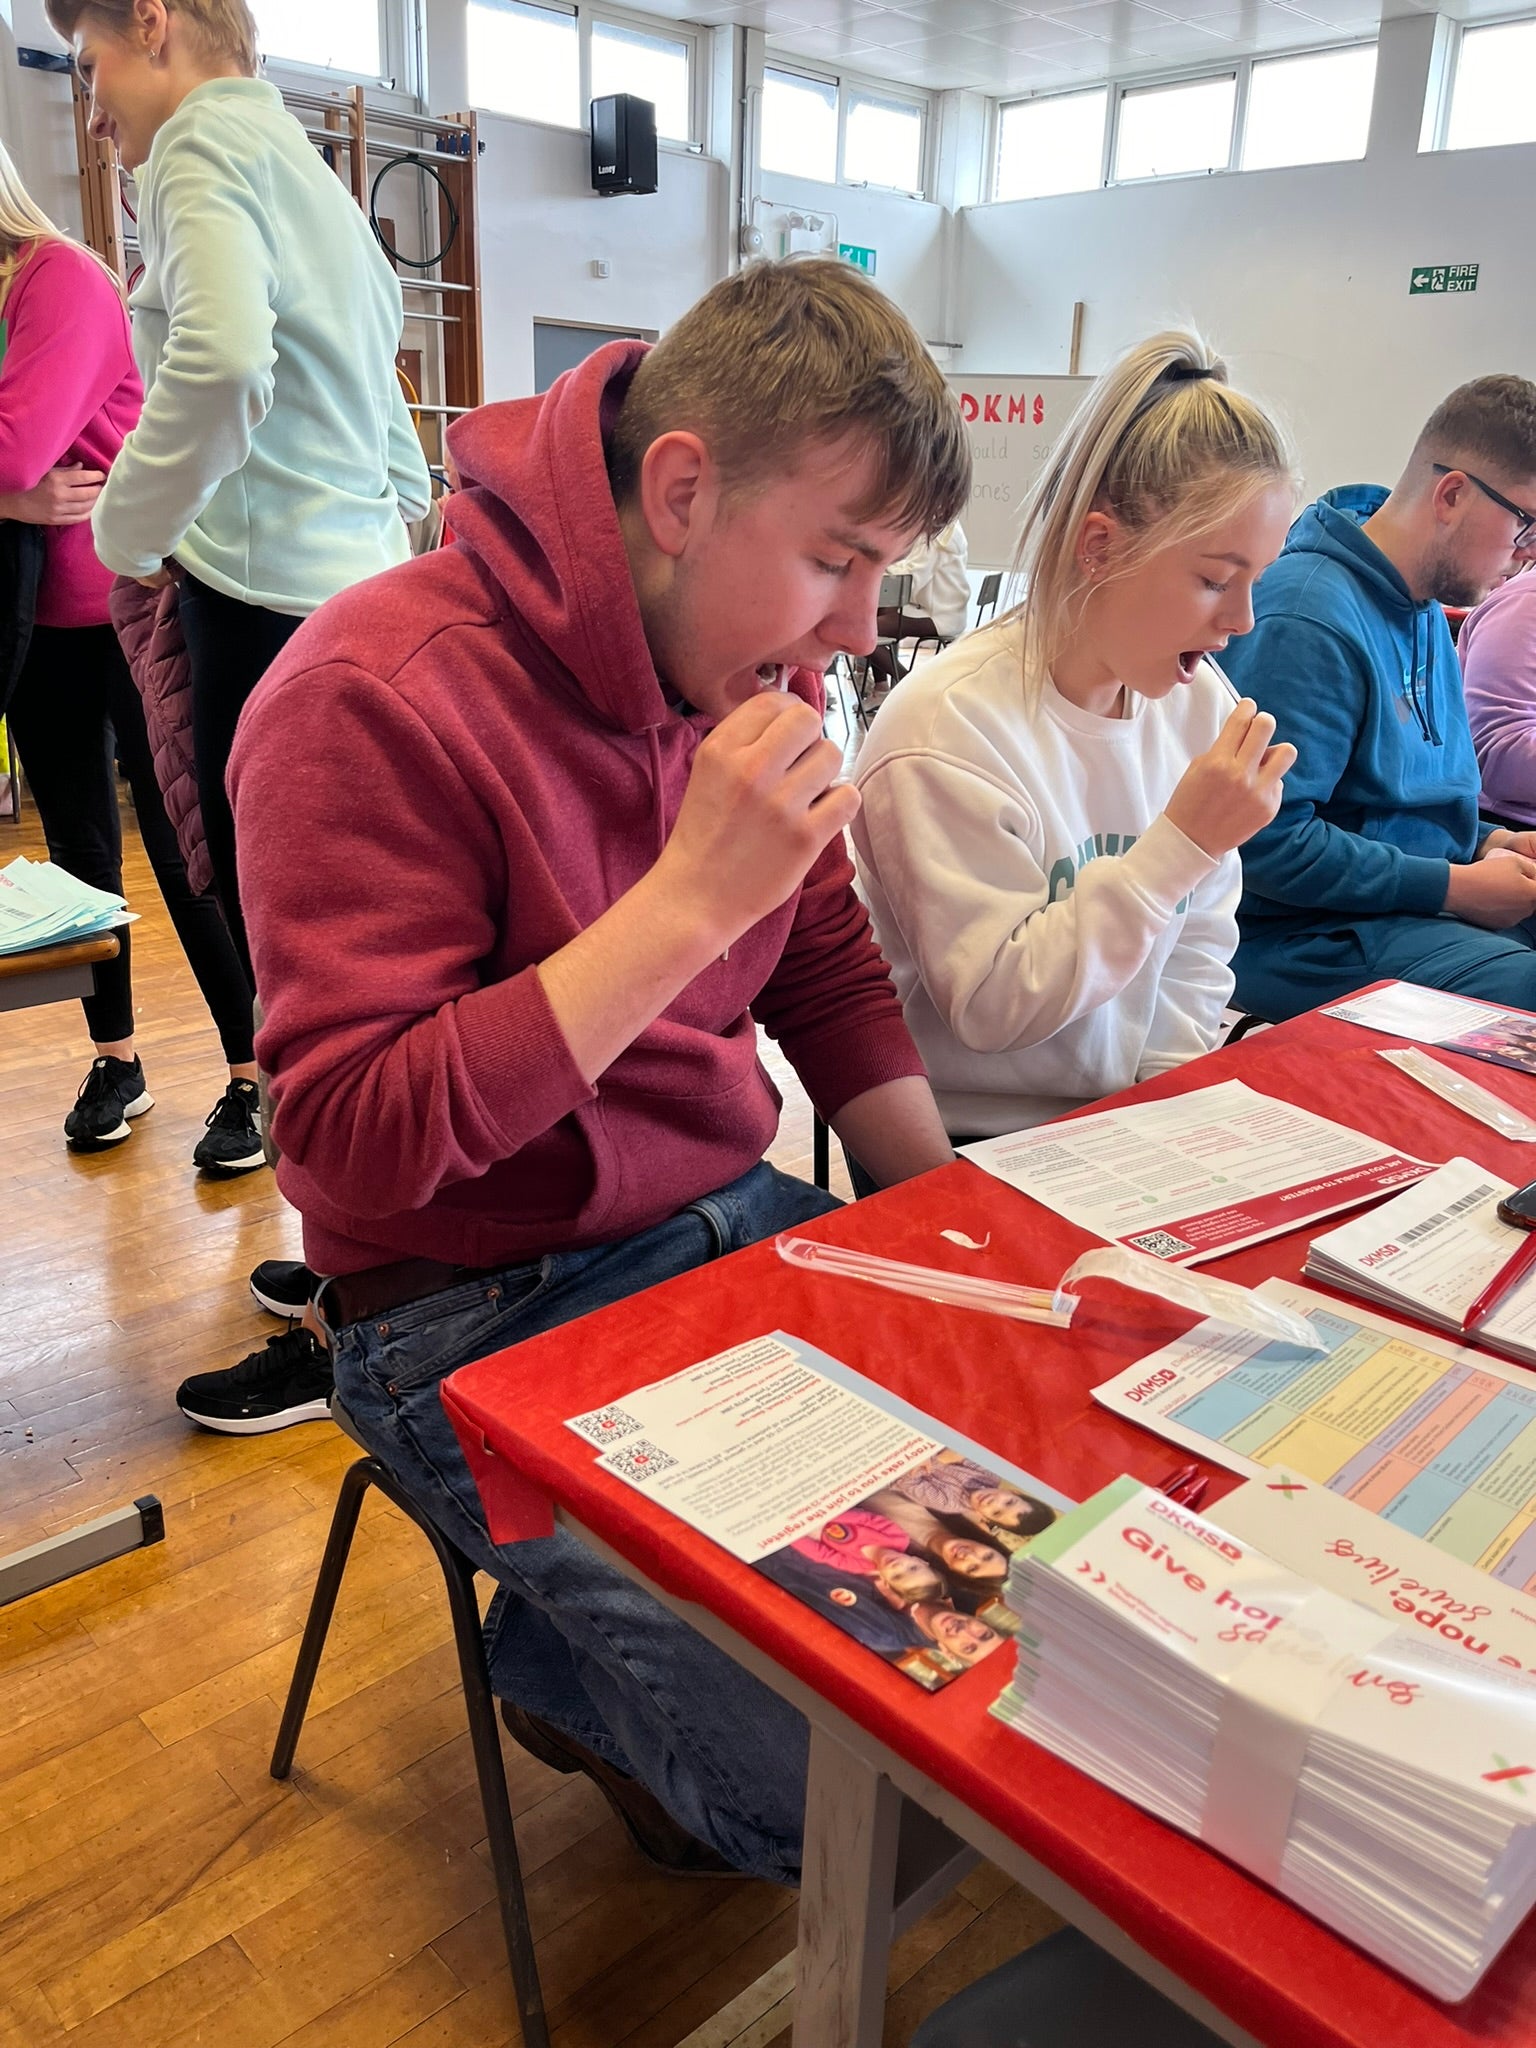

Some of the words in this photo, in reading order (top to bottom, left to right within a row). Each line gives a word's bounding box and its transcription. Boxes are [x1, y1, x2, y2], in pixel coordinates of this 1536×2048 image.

[1449, 265, 1477, 277] FIRE
[1447, 280, 1474, 291] EXIT
[961, 393, 1044, 424] DKMS
[975, 436, 1008, 459] ould
[973, 483, 1010, 501] one's
[1358, 1247, 1393, 1267] DKMS
[1124, 1373, 1167, 1403] DKMS
[902, 1440, 937, 1461] Tracy
[879, 1459, 907, 1477] asks
[857, 1473, 882, 1489] you
[823, 1493, 851, 1511] join
[846, 1487, 862, 1497] to
[804, 1508, 828, 1522] the
[756, 1518, 808, 1550] register!
[1121, 1526, 1206, 1594] Give
[1325, 1539, 1400, 1585] lives
[1399, 1578, 1492, 1621] save
